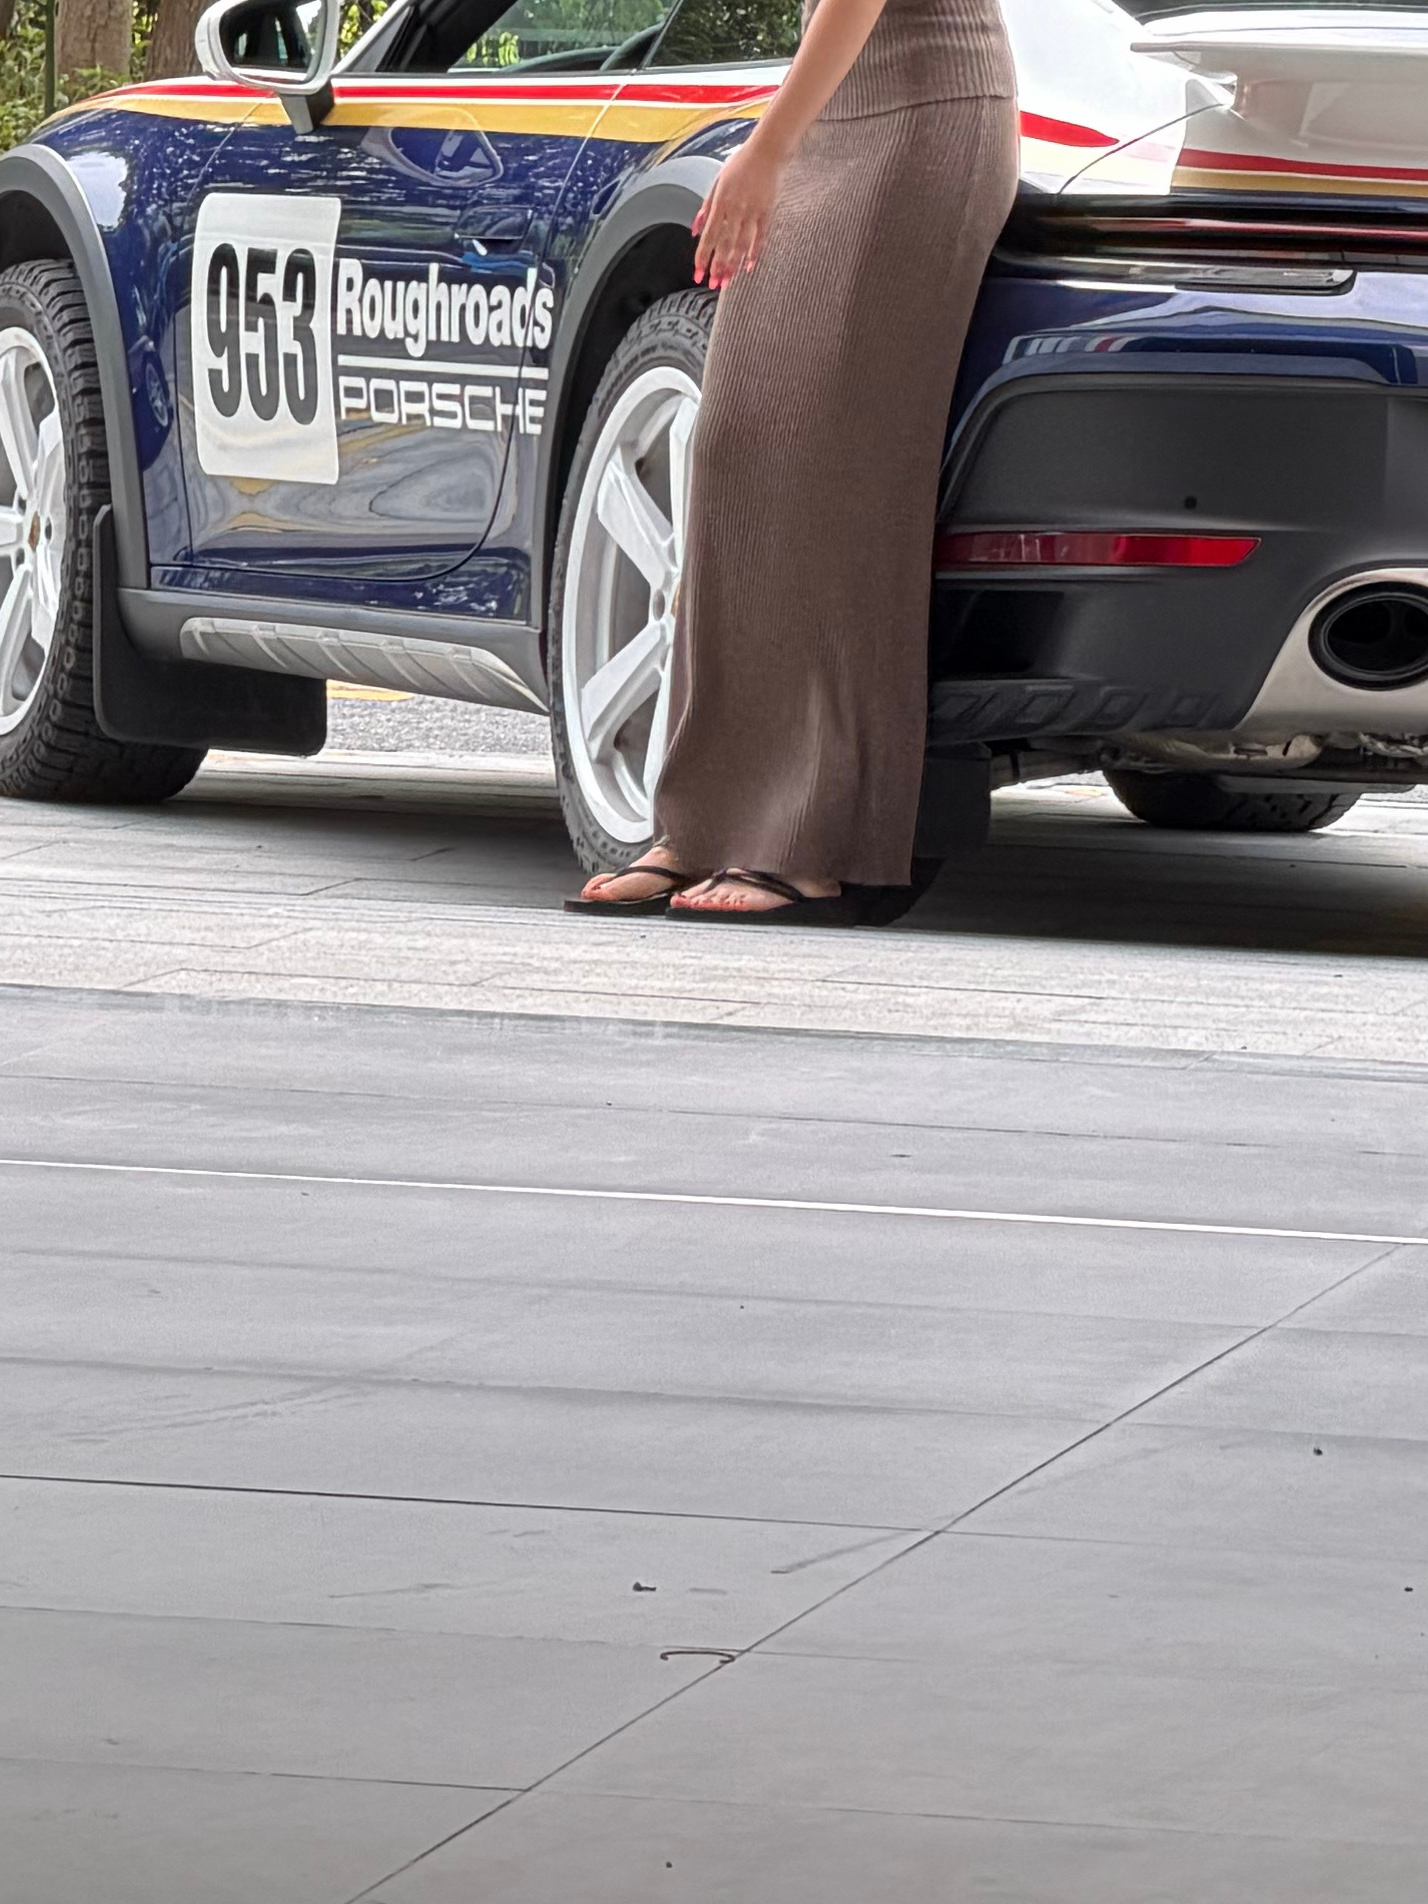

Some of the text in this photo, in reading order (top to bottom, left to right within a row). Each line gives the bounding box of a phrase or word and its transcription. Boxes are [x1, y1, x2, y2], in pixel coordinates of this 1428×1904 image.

[206, 242, 318, 426] 953
[337, 258, 555, 358] Roughroads
[338, 375, 548, 435] PORSCHE
